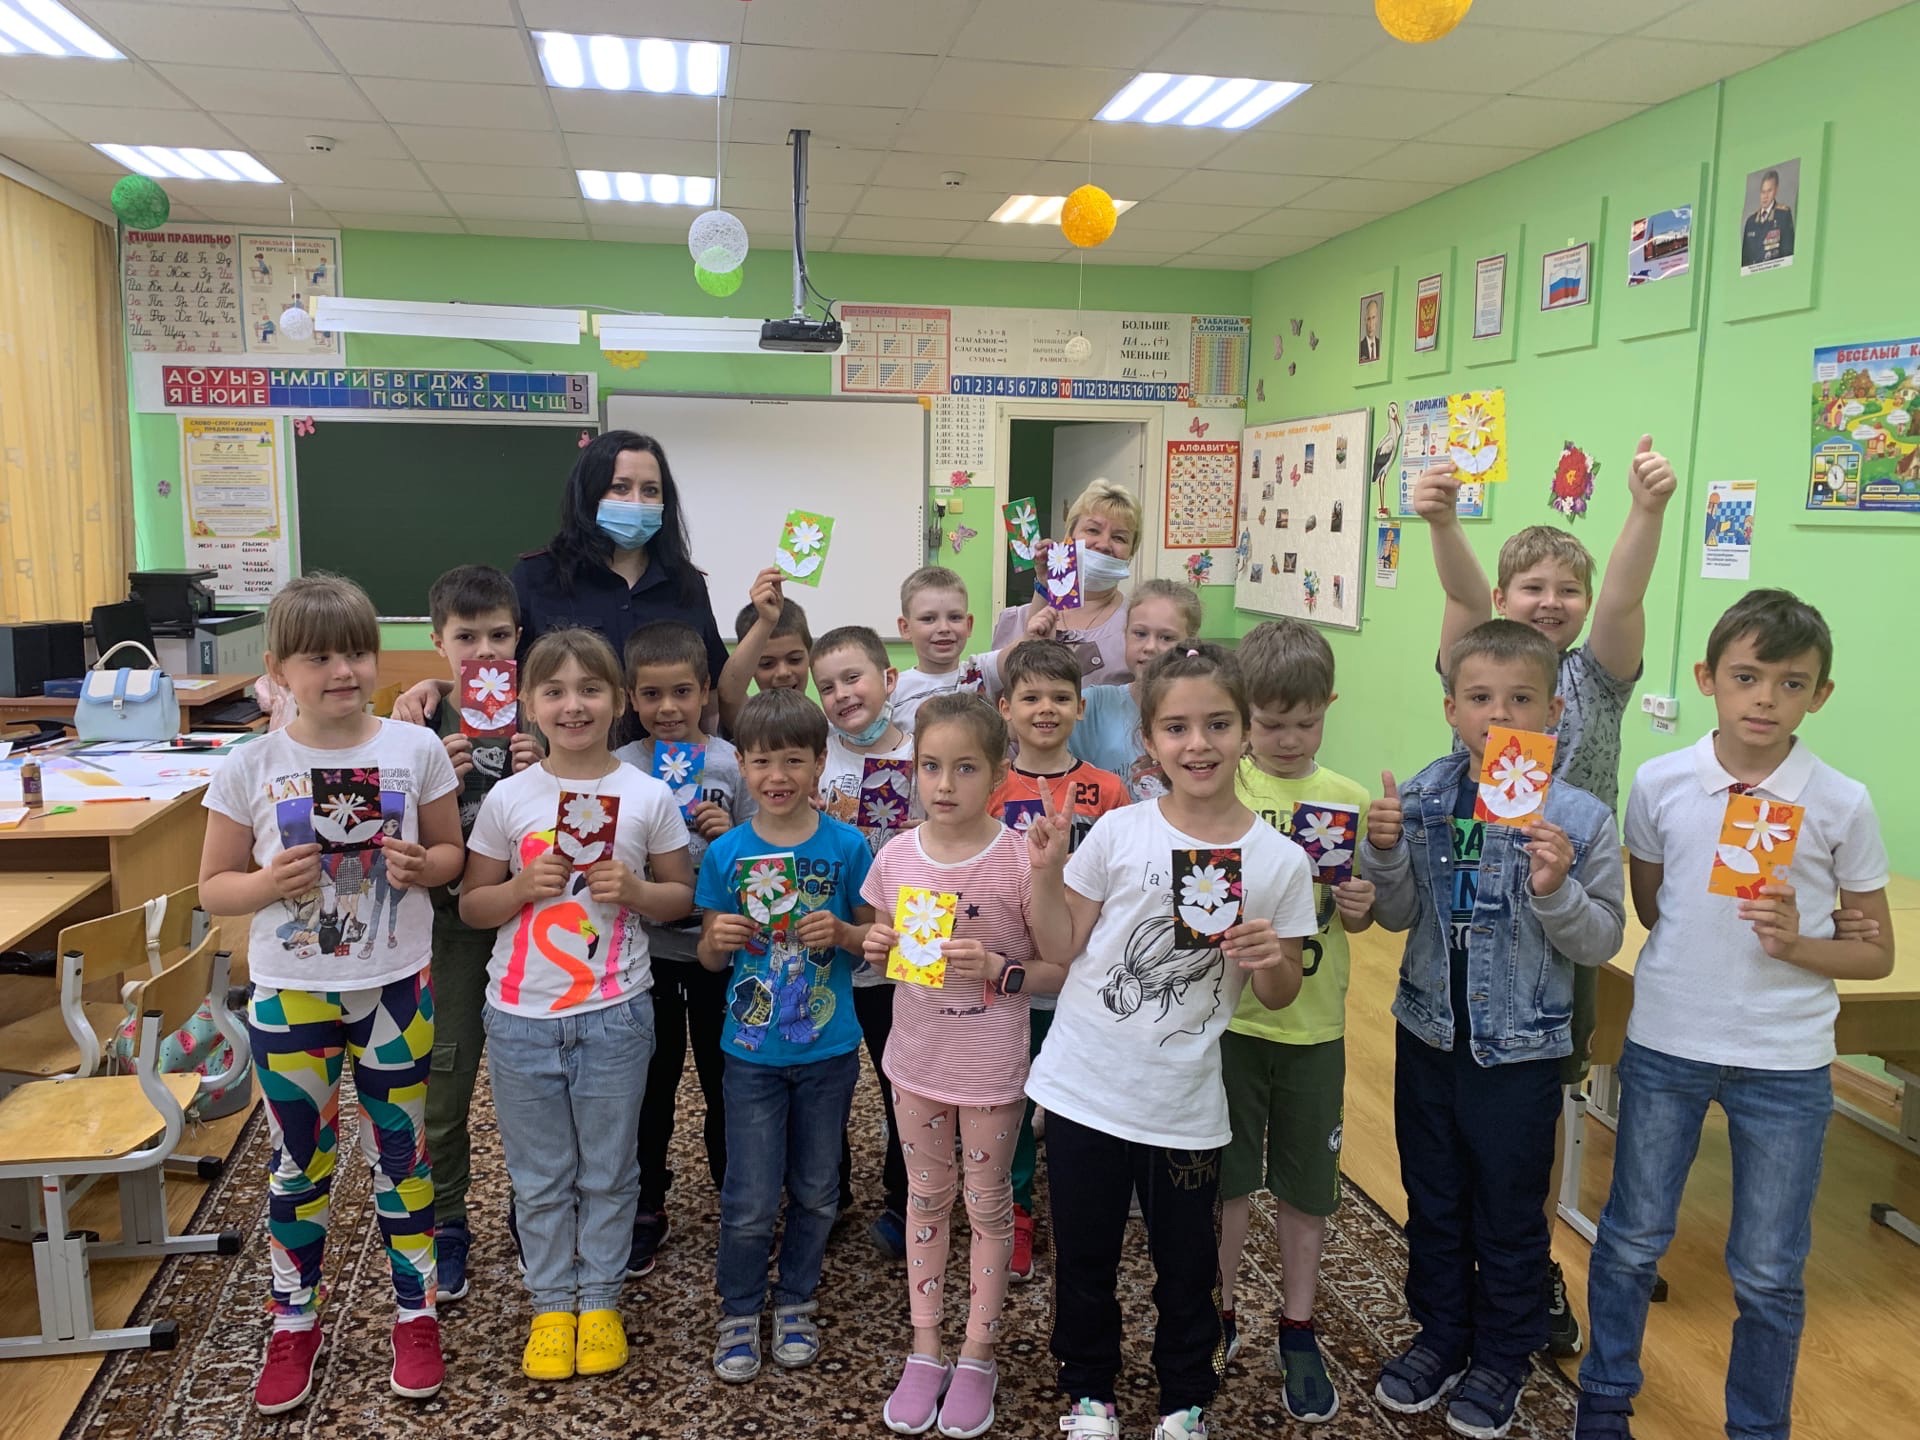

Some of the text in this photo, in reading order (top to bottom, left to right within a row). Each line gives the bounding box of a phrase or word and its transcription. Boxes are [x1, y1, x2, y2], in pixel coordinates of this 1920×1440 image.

[128, 231, 231, 244] ПИШИ ПРАВИЛЬНО
[1122, 320, 1171, 331] БОЛЬШЕ
[1123, 337, 1137, 346] НА
[1120, 350, 1171, 361] МЕНЬШЕ
[1122, 367, 1137, 378] НА
[167, 370, 184, 384] А
[188, 370, 205, 385] О
[209, 370, 225, 385] У
[230, 371, 246, 385] Ы
[252, 371, 265, 385] Э
[271, 371, 285, 385] Н
[289, 371, 308, 386] М
[311, 372, 327, 386] Л
[334, 371, 345, 386] Р
[374, 374, 385, 387] Б
[394, 375, 404, 388] В
[414, 375, 424, 388] Г
[431, 375, 446, 390] Д
[450, 376, 468, 389] Ж
[473, 376, 484, 390] З
[573, 379, 582, 392] Ь
[953, 379, 1189, 399] 0 1 2 3 4 5 6 7 8 9 10 11 12 13 14 15 16 17 18 19 20
[169, 387, 583, 410] Я Ё Ю И Е П Ф К Т Ш С Х Ц Ч Щ Ъ
[1179, 444, 1225, 452] АЛФАВИТ
[1075, 782, 1100, 806] 23
